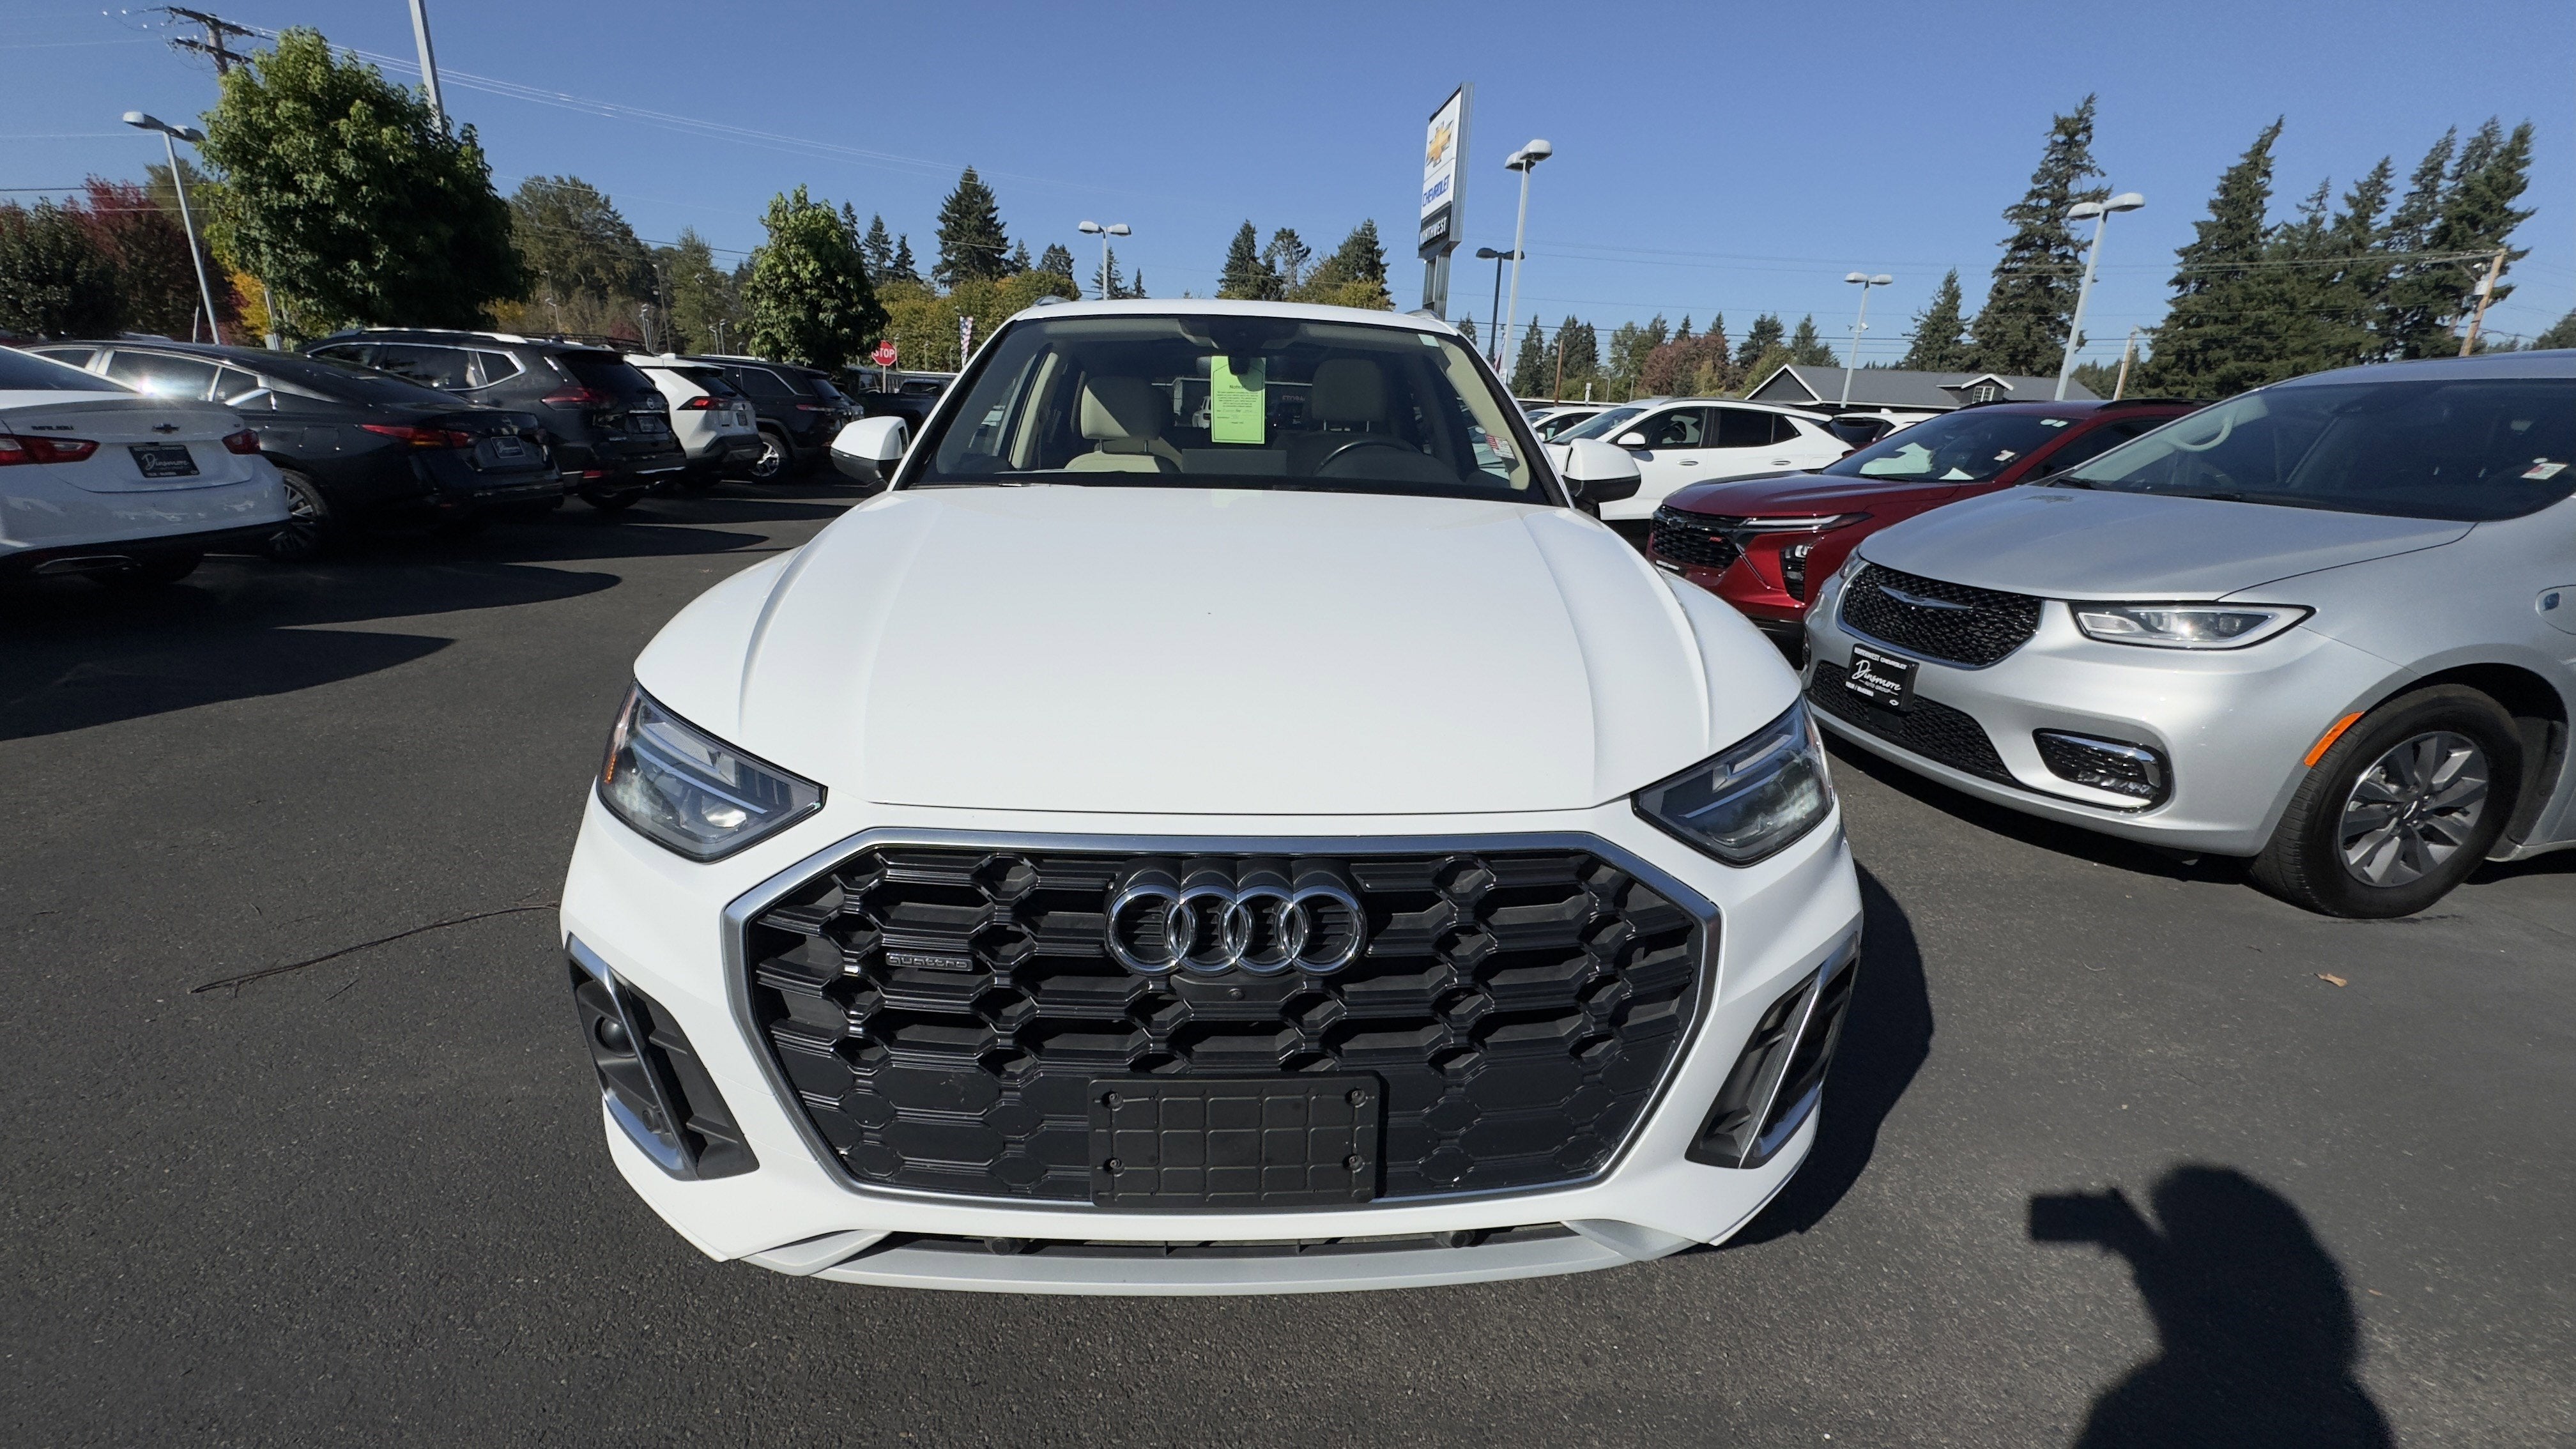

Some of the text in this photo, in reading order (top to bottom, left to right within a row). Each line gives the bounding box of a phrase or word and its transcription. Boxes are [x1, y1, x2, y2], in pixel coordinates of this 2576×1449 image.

[873, 348, 895, 358] STOP
[1851, 659, 1901, 691] Dinsmore
[889, 956, 968, 968] quattro
